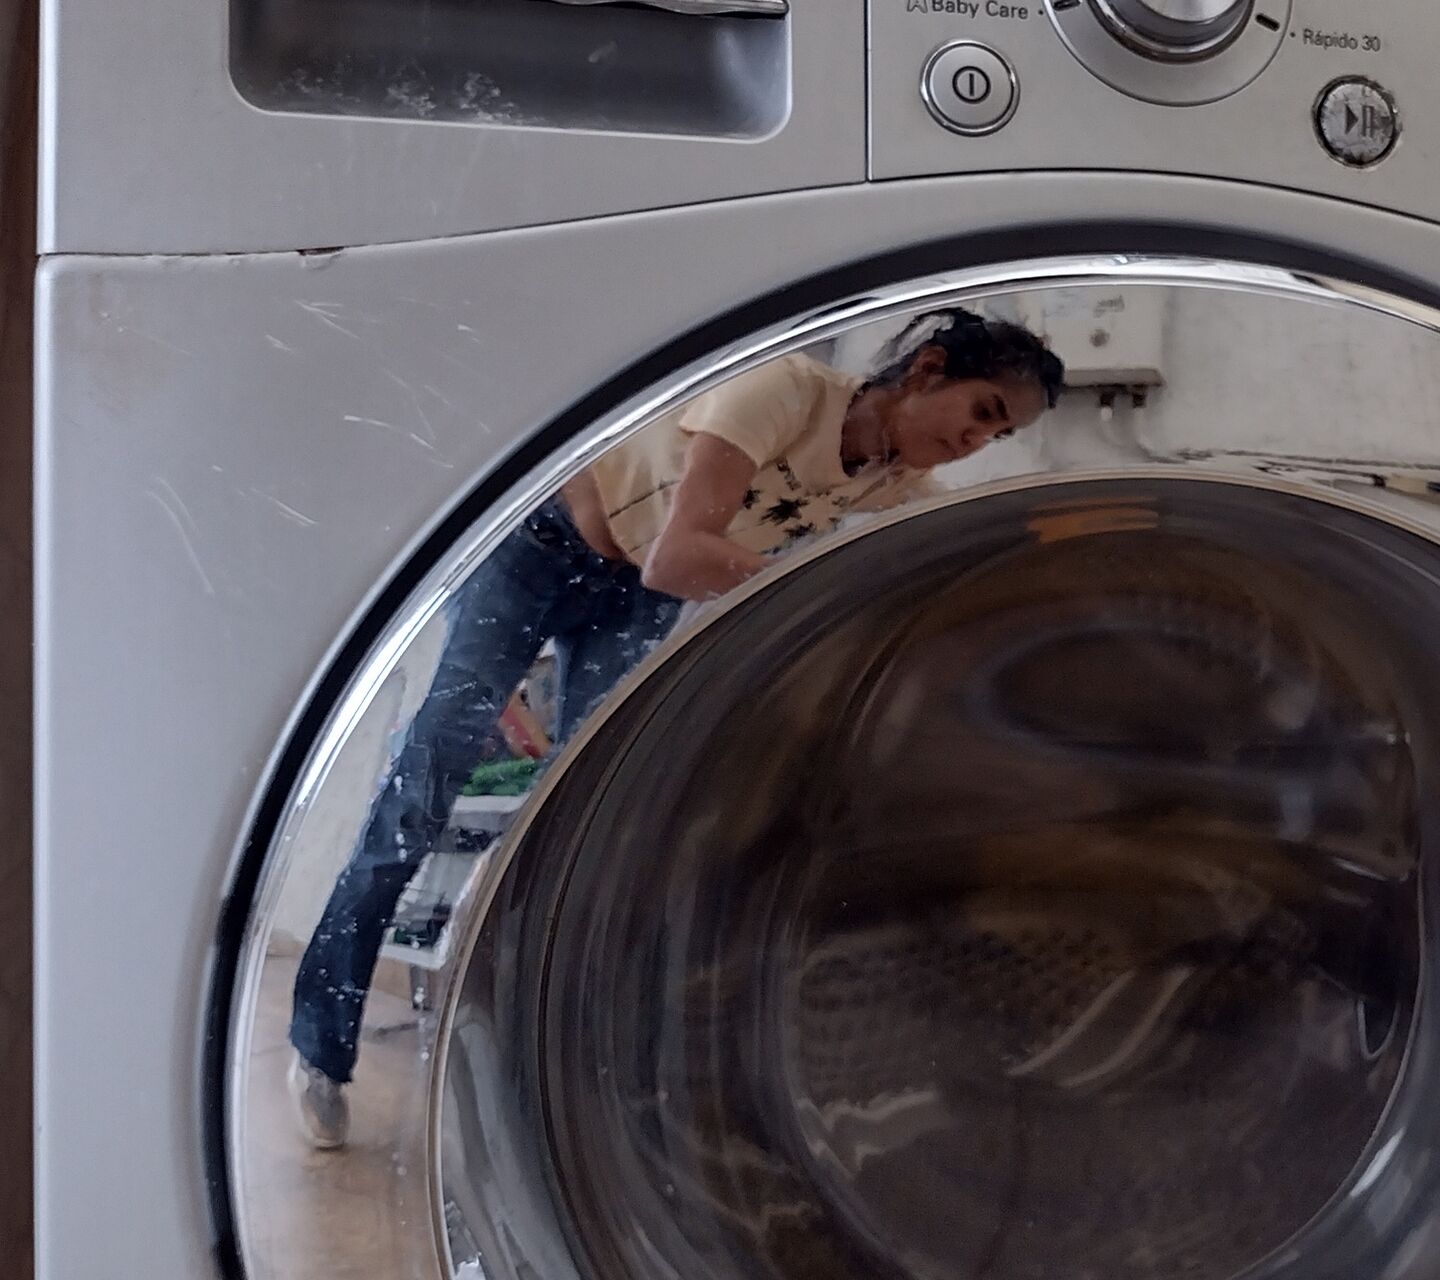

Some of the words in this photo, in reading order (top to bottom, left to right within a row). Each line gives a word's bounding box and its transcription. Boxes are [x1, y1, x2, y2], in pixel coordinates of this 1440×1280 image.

[985, 0, 1028, 19] Care
[1303, 28, 1358, 50] Rápido
[1361, 35, 1381, 52] 30
